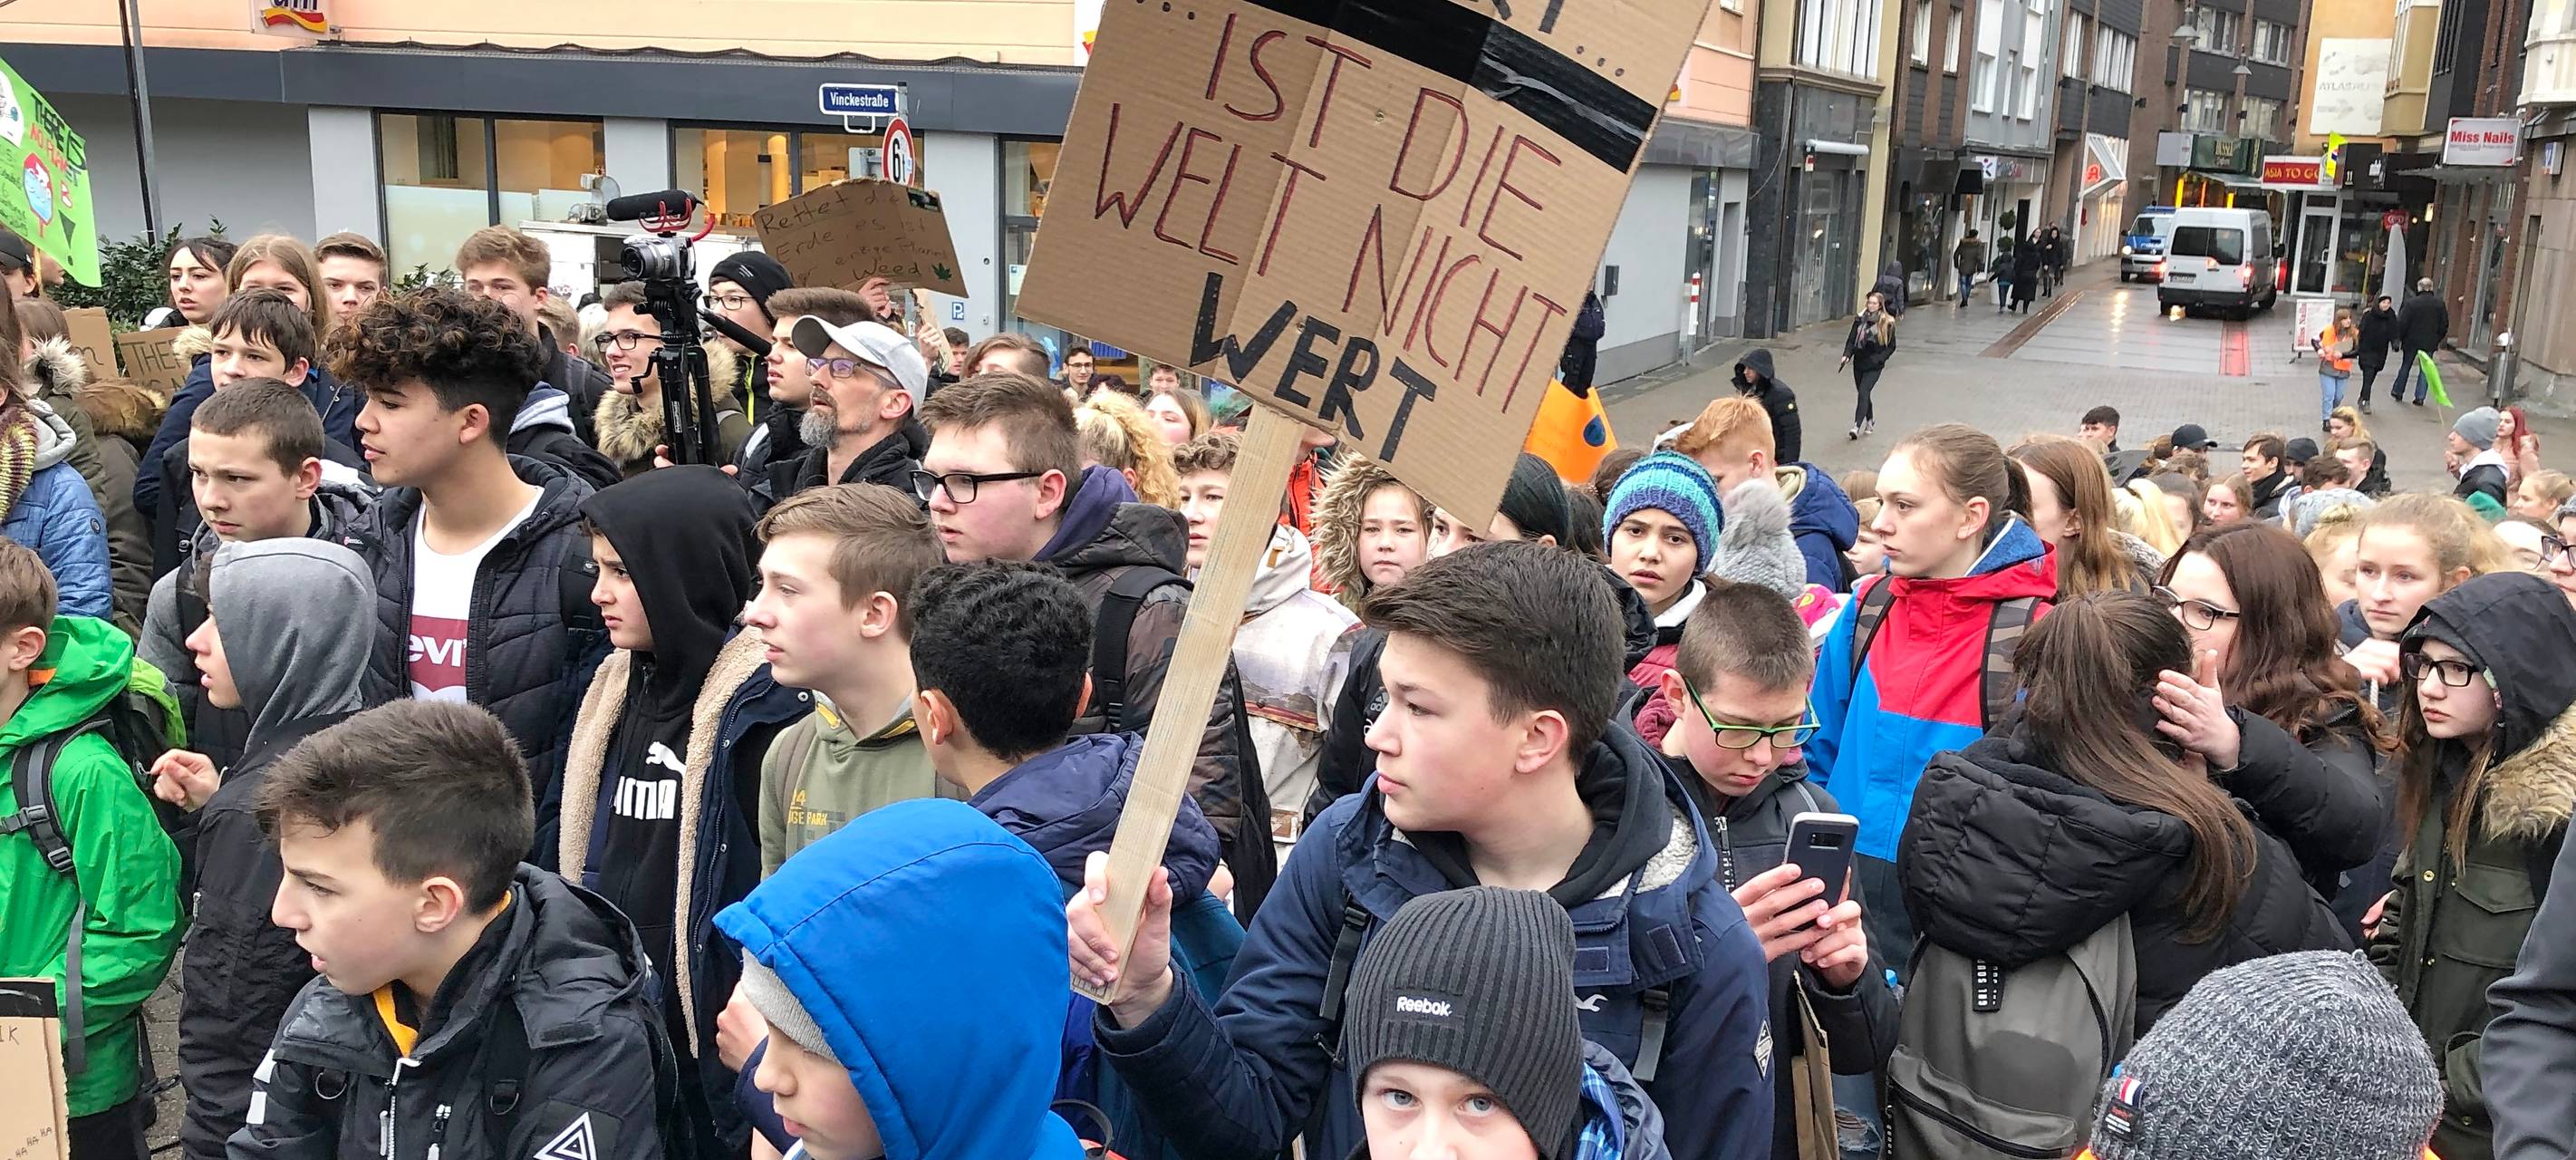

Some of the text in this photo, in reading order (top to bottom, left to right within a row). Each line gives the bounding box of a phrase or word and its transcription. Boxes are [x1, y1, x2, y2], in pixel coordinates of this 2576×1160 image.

[830, 92, 889, 108] Vinckestraße
[30, 122, 43, 149] NO
[31, 92, 88, 170] THERE IS
[1206, 14, 1372, 149] IST
[1389, 87, 1562, 261] DIE
[2451, 131, 2515, 144] Miss Nails
[2265, 169, 2282, 179] ASIA
[2285, 168, 2301, 179] TO
[762, 189, 849, 234] Rettet
[853, 258, 922, 281] Weed
[1095, 103, 1567, 413] WELT NICHT
[1189, 272, 1437, 463] WERT
[410, 634, 468, 667] evi'
[614, 776, 677, 820] MA
[807, 812, 828, 826] PARK
[1396, 996, 1452, 1016] Reebok
[26, 1136, 40, 1146] HA
